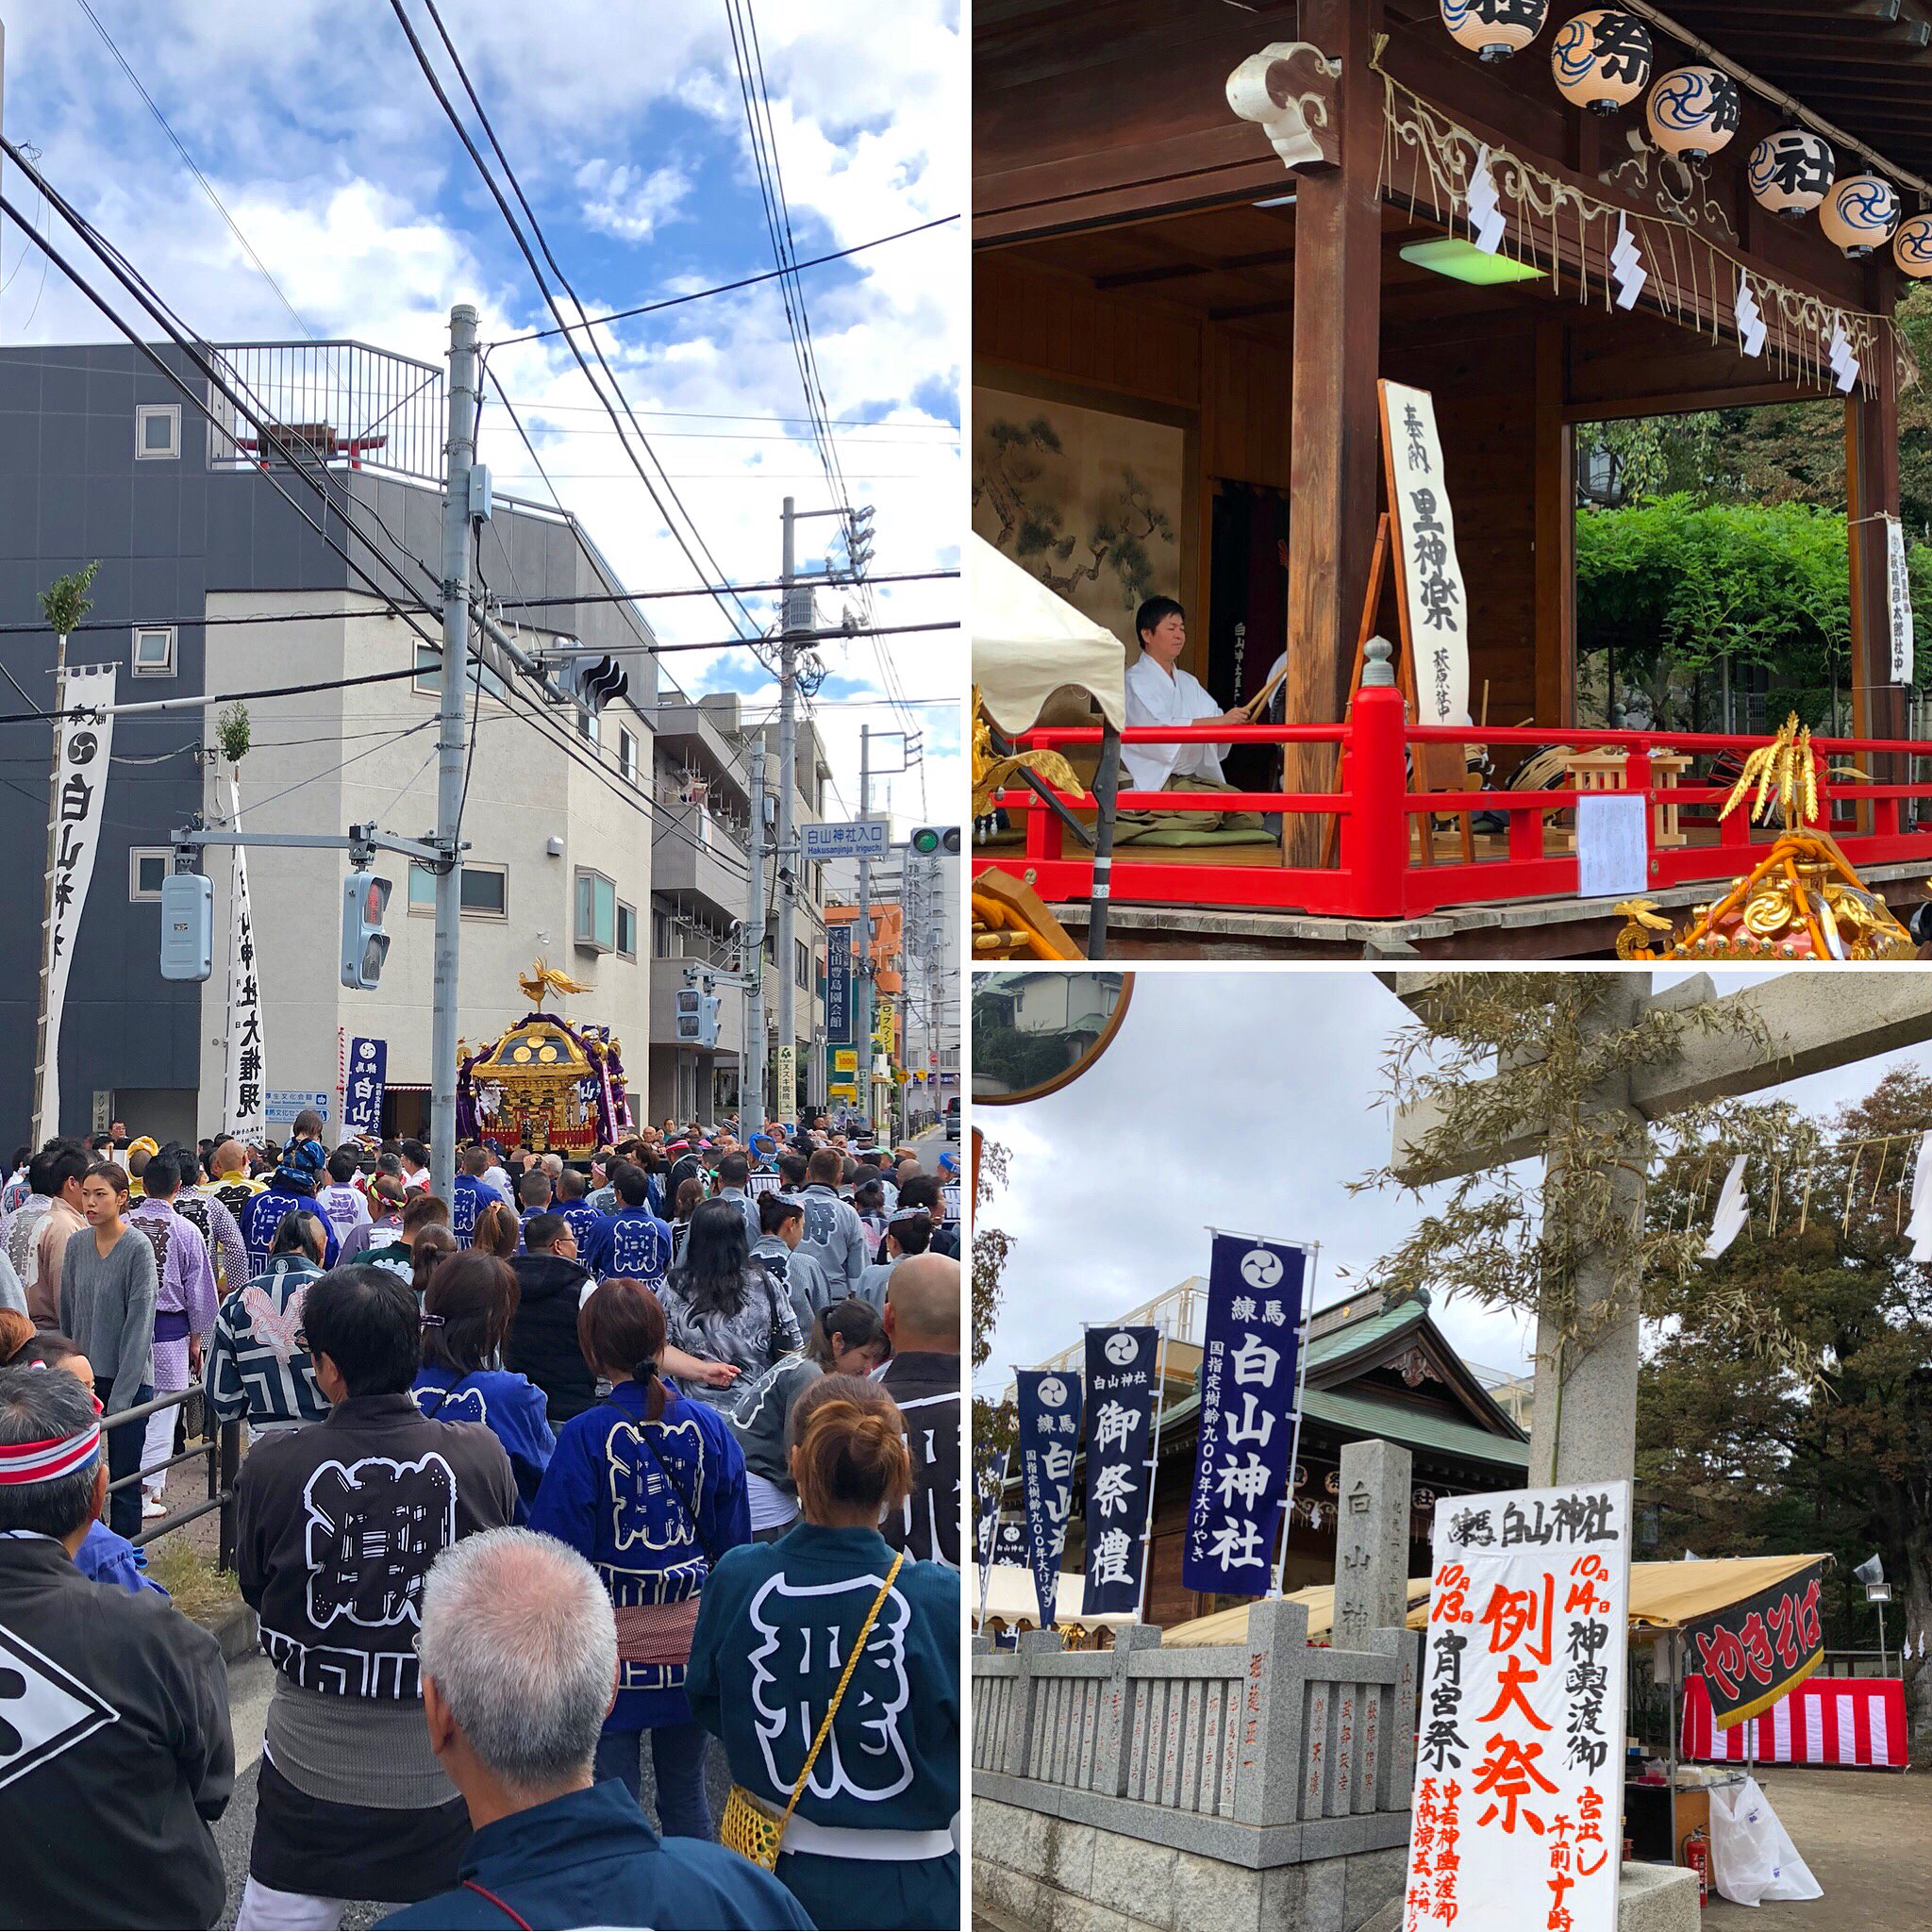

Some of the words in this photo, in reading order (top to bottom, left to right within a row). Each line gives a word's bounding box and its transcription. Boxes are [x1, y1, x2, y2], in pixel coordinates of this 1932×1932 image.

[1590, 12, 1653, 88] 祭
[1771, 138, 1835, 200] 社
[1403, 403, 1432, 475] 奉納
[1409, 487, 1460, 633] 里神楽
[808, 826, 882, 844] 白山神社入口
[808, 844, 854, 855] Hakusanjinja
[856, 843, 882, 854] Iriguchi
[1230, 1295, 1287, 1327] 練馬
[1092, 1370, 1148, 1391] 白山神社
[1036, 1413, 1076, 1435] 練馬
[1207, 1331, 1281, 1573] 白山神社
[1091, 1399, 1142, 1588] 御祭禮
[1415, 1490, 1435, 1507] 社
[996, 1543, 1025, 1552] 白山神社
[1435, 1564, 1472, 1591] 10月
[1570, 1554, 1609, 1582] 10月
[1563, 1579, 1610, 1616] 14日
[1695, 1578, 1822, 1701] やきそば
[1419, 1628, 1470, 1773] 宵宮祭
[1471, 1573, 1559, 1836] 例大祭
